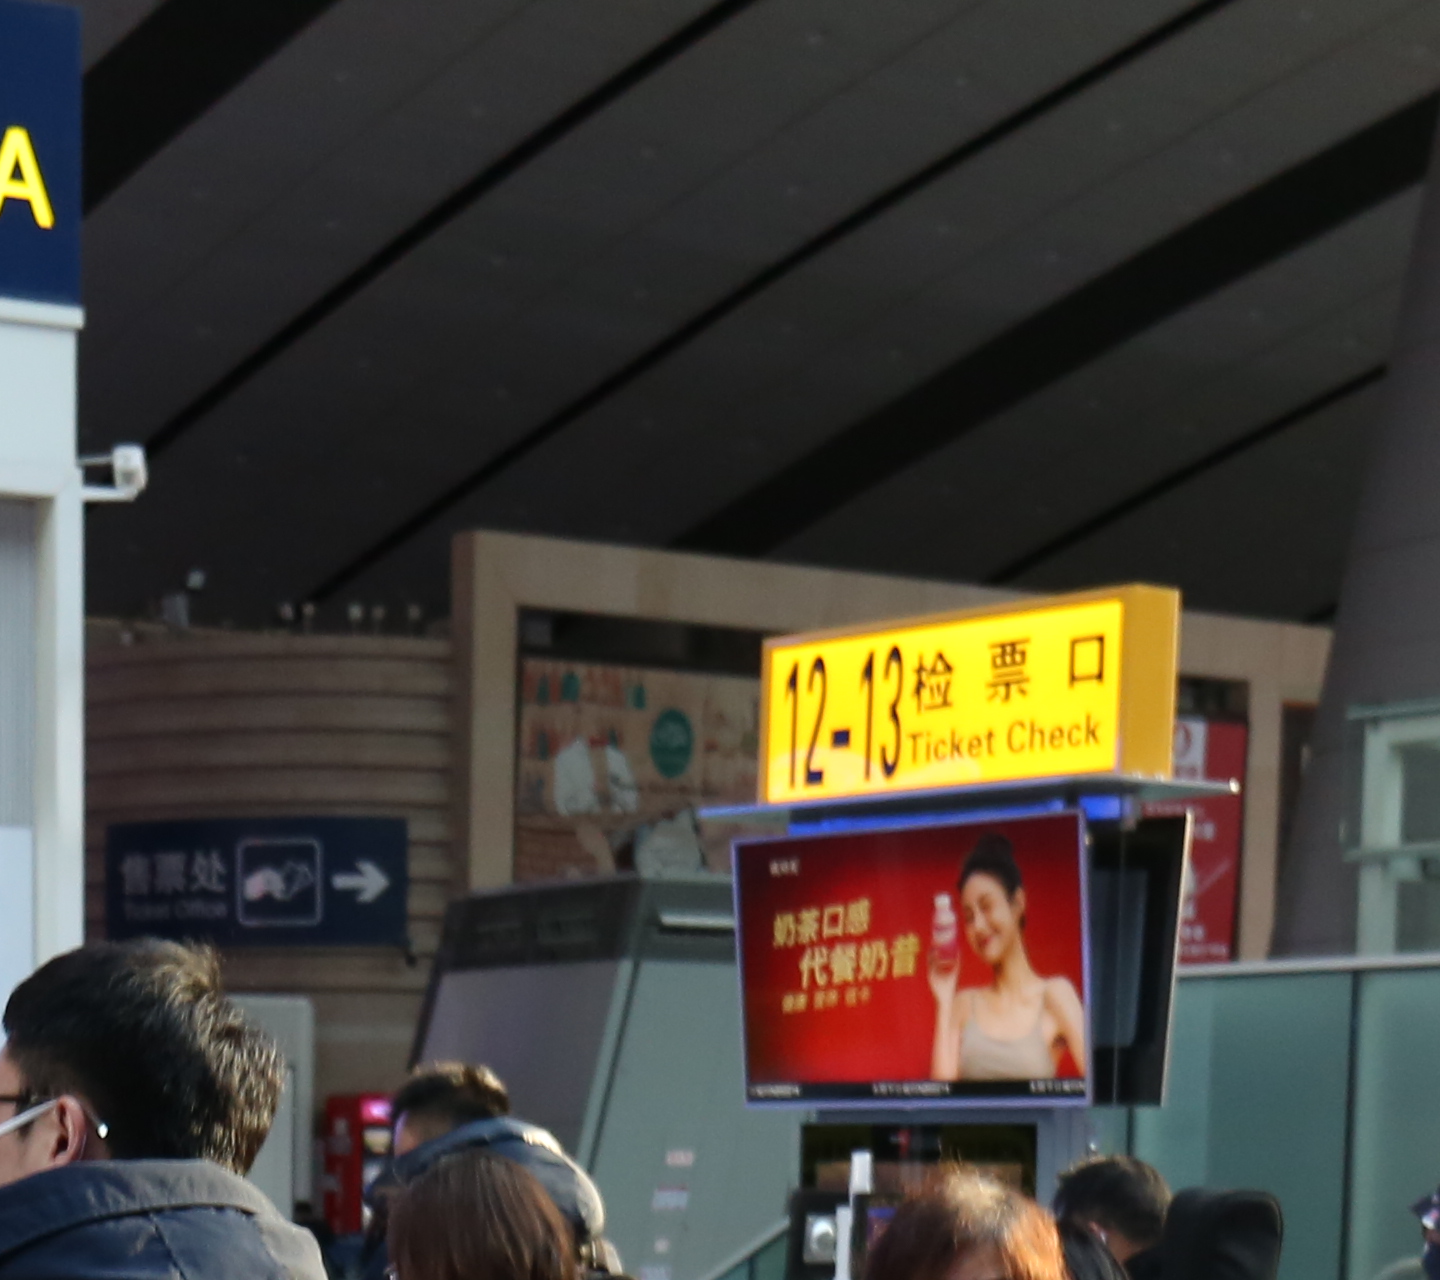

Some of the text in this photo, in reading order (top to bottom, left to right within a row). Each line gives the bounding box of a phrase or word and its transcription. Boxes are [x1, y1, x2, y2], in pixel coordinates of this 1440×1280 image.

[913, 633, 1106, 714] 检票口
[784, 645, 906, 788] 12-13
[908, 711, 1102, 765] Ticket Check
